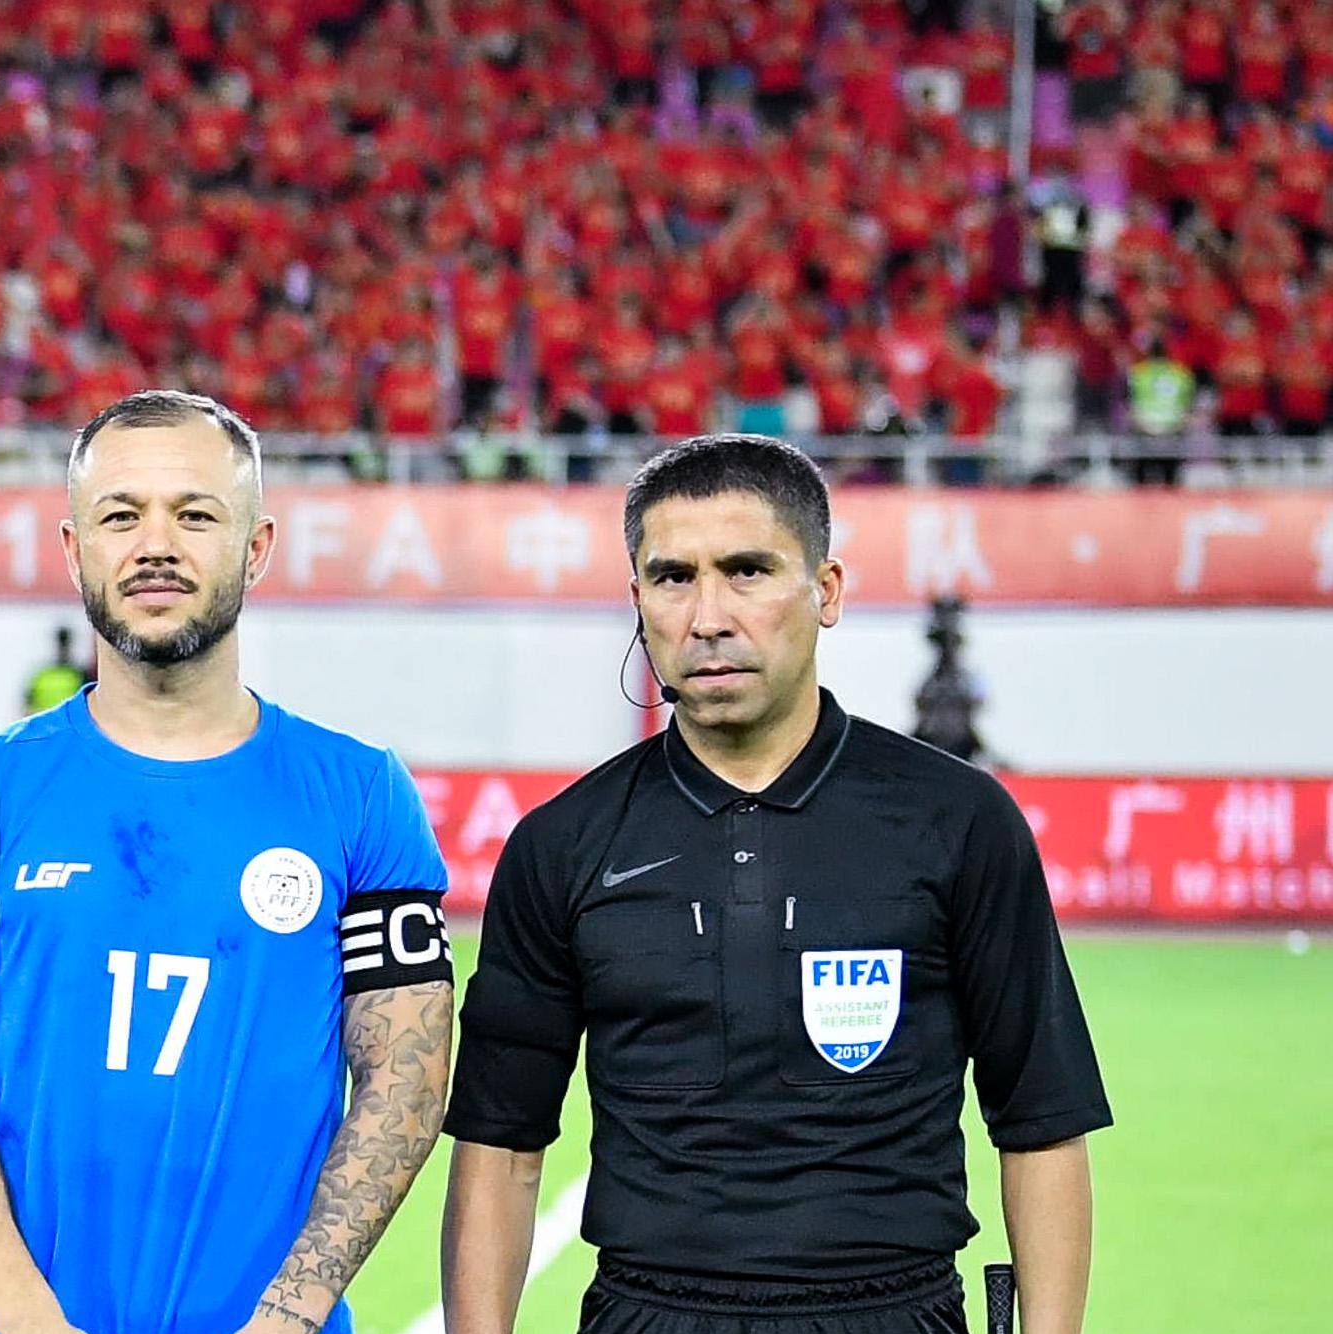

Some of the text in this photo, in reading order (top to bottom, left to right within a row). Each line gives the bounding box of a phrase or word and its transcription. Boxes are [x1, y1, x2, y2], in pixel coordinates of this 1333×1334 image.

[813, 959, 890, 986] FIFA
[106, 950, 210, 1075] 17
[833, 1045, 870, 1060] 2019
